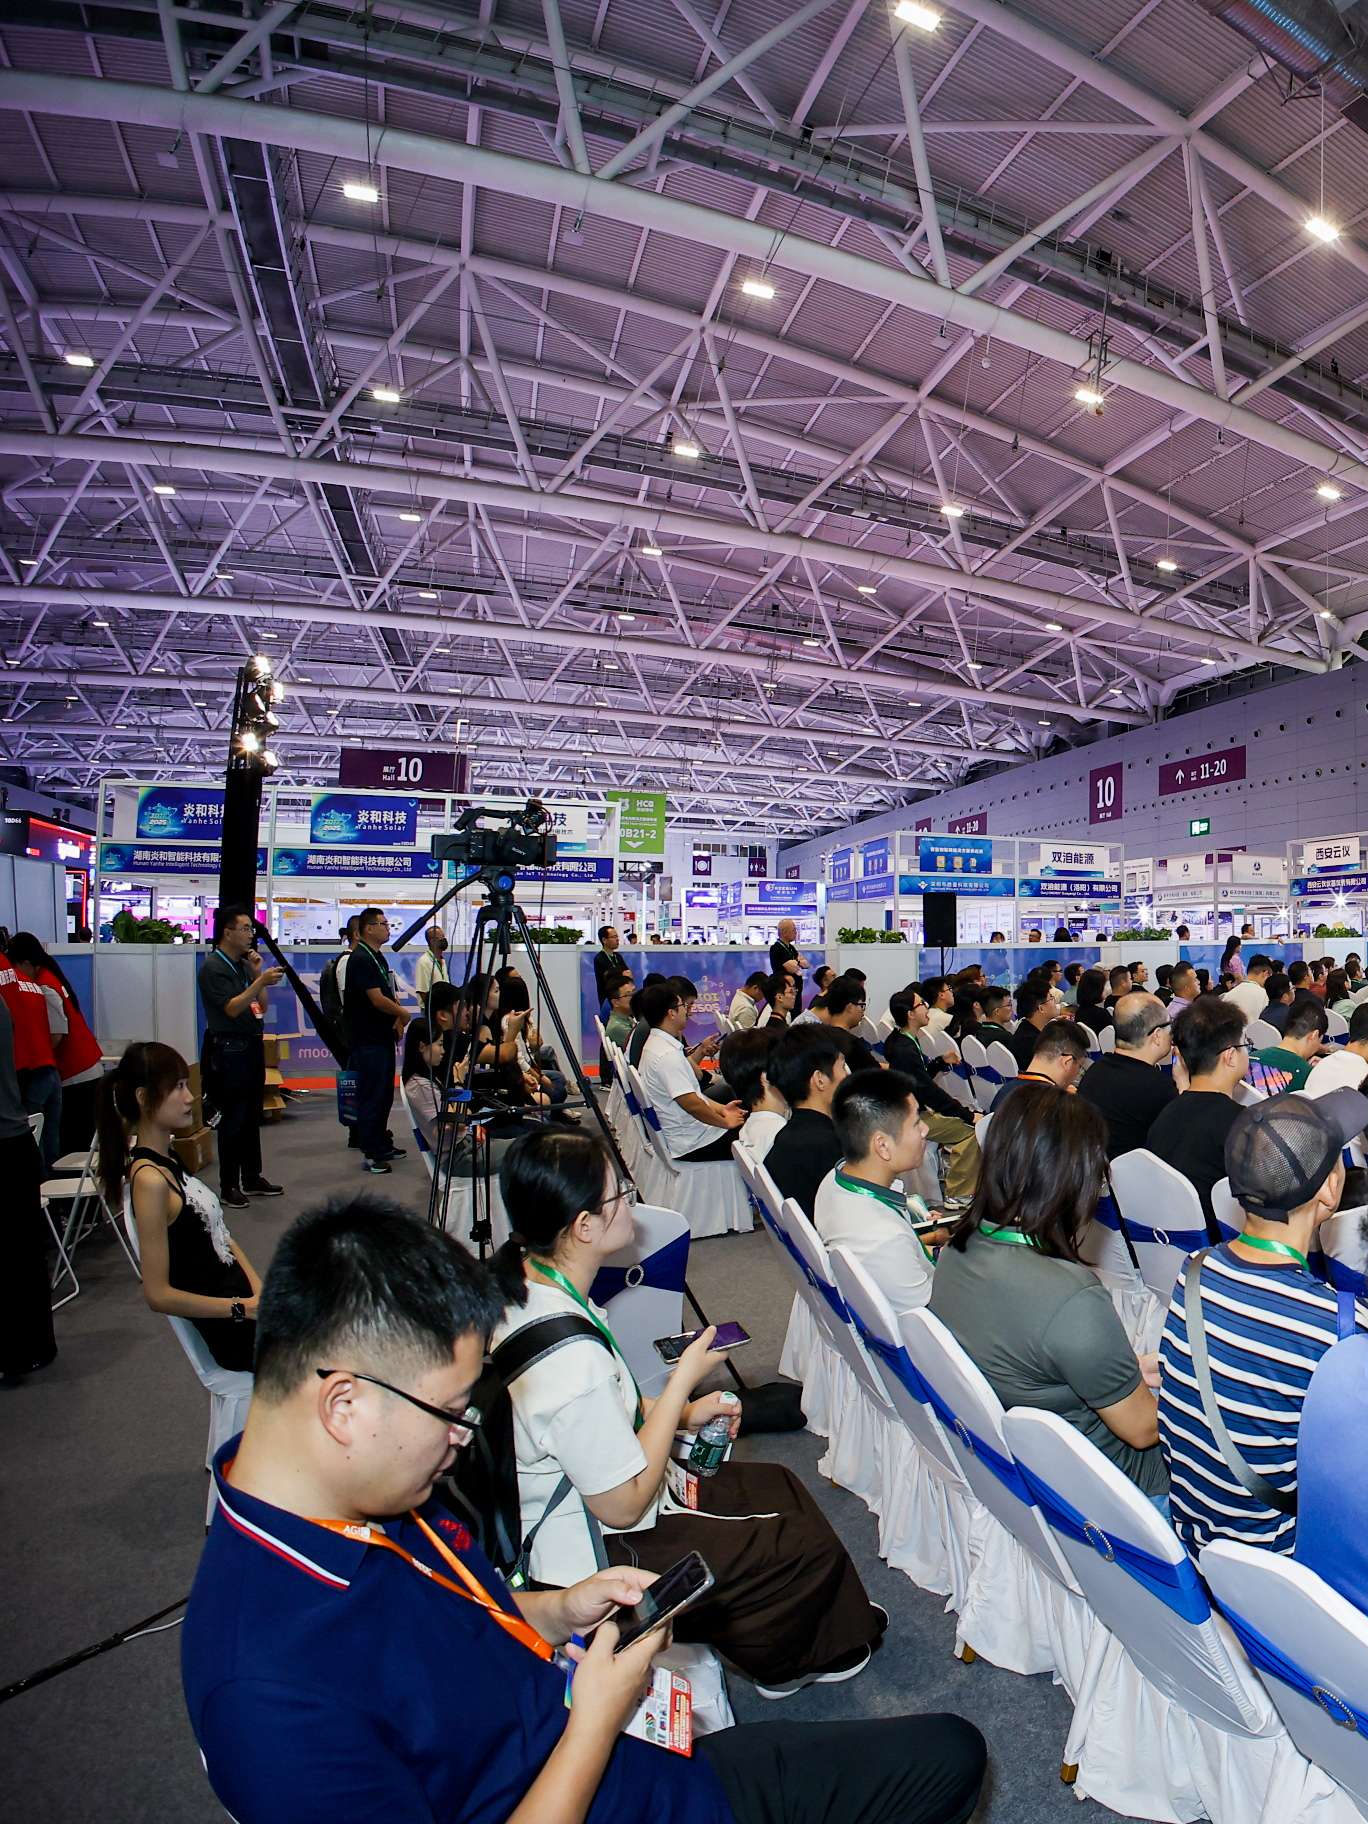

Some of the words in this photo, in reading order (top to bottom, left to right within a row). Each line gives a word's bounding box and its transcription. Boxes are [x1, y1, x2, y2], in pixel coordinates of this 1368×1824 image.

[397, 757, 423, 782] 10
[1200, 759, 1227, 779] 11-20
[1096, 776, 1115, 808] 10
[357, 810, 407, 824] 炎和科技
[133, 850, 221, 862] 湖南炎和智能科技有限
[307, 854, 411, 867] 湖南炎和智能科技有限公司
